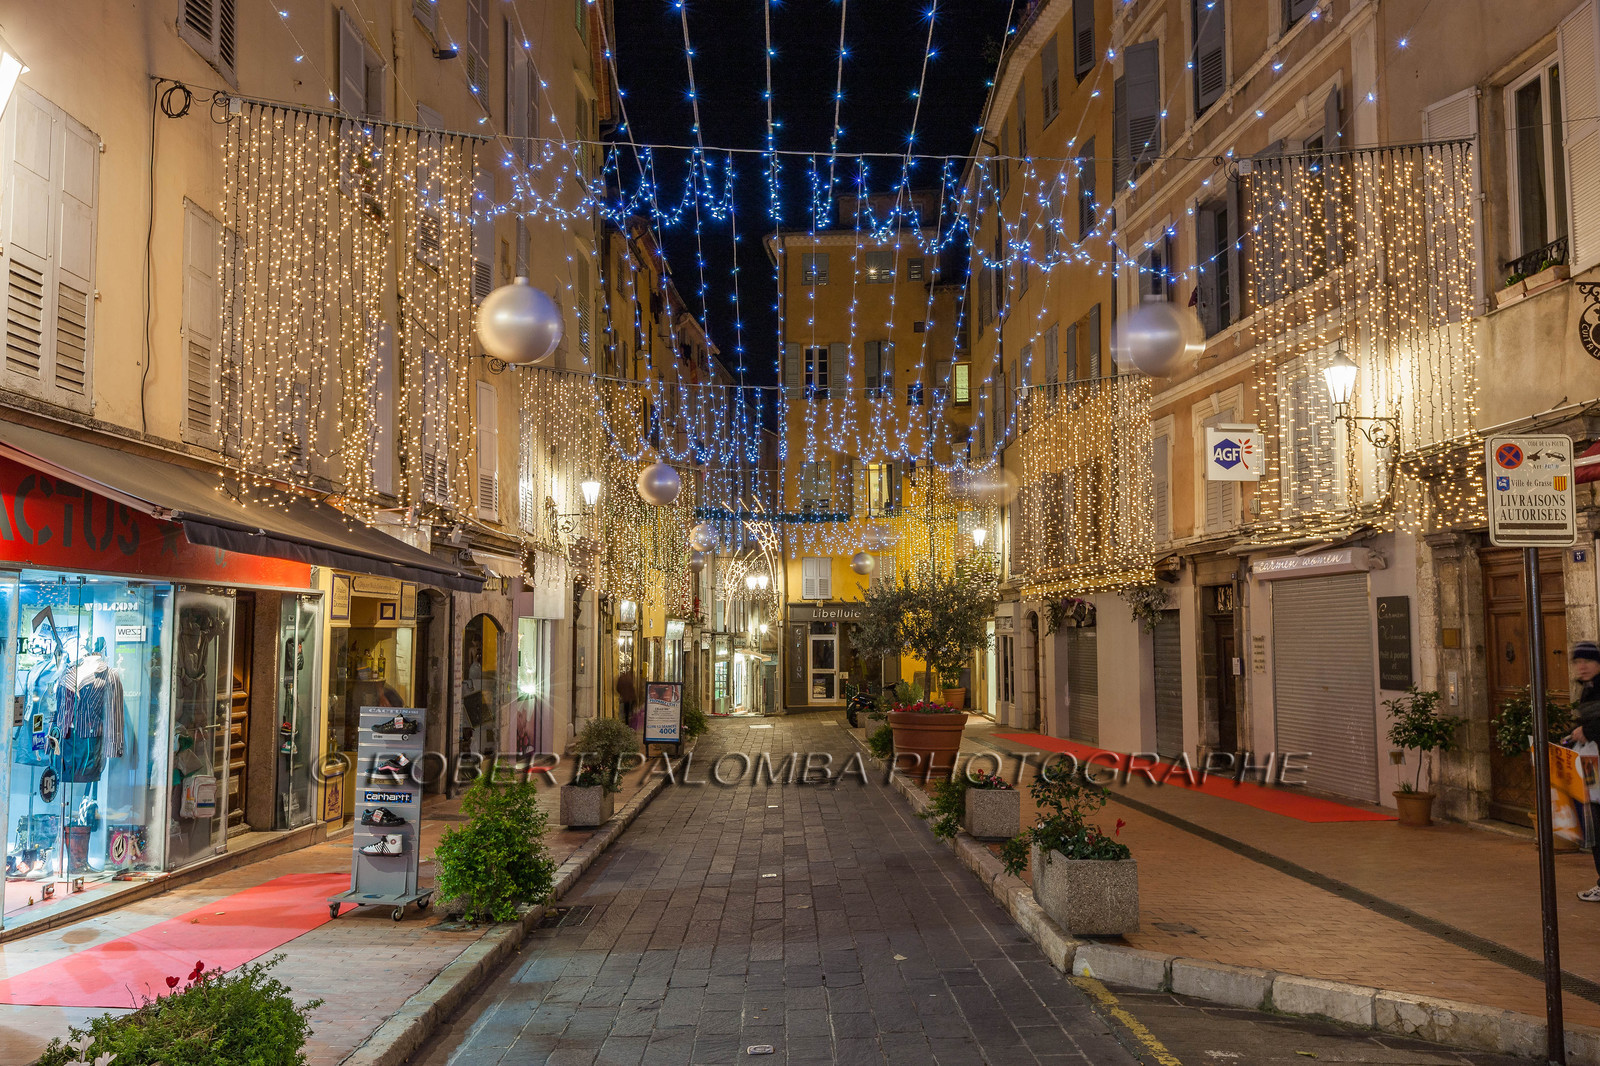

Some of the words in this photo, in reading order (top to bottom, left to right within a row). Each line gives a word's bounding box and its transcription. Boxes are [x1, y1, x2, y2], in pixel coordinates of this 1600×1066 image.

[1214, 448, 1240, 461] AGF
[1511, 479, 1524, 487] Ville
[1526, 479, 1532, 487] de
[1534, 479, 1552, 487] Grasse
[1500, 494, 1566, 507] LIVRAISONS
[84, 602, 139, 612] VOLCOM
[366, 793, 410, 801] carhartt
